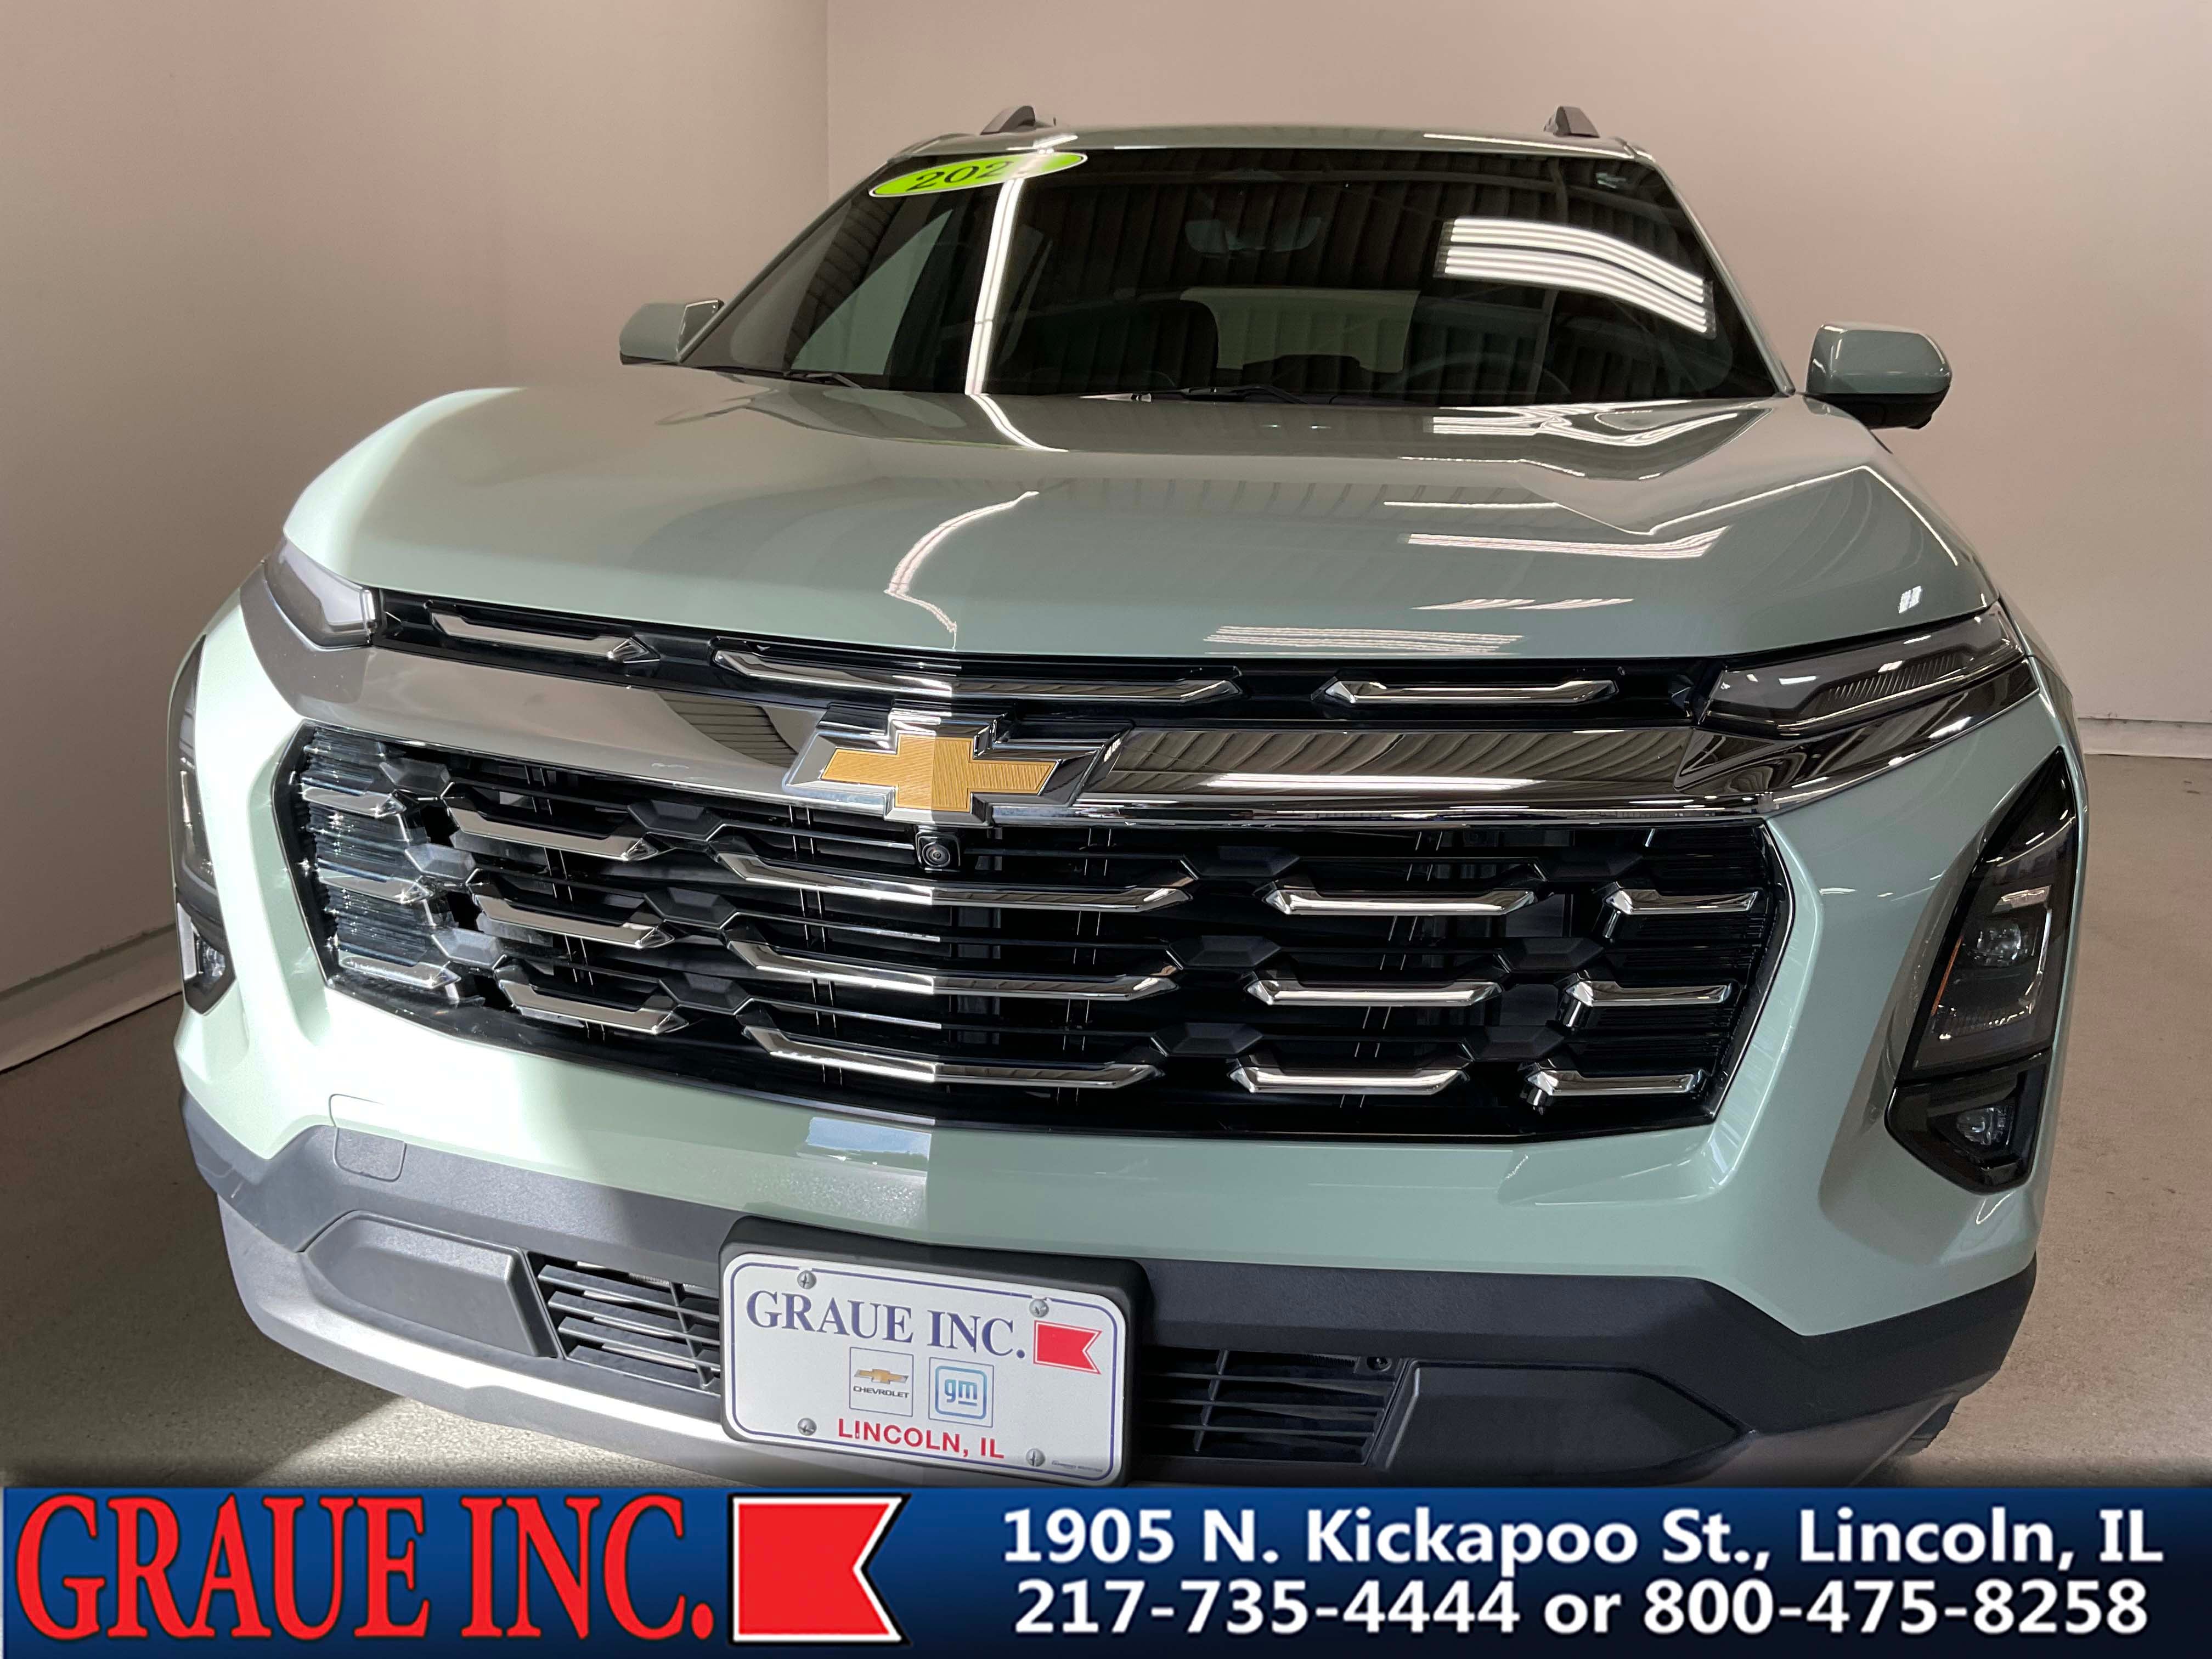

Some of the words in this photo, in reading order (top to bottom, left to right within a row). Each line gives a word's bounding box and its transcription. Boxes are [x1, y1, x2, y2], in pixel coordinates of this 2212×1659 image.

[906, 159, 1034, 191] 202
[746, 1290, 914, 1344] GRAUE
[927, 1309, 1026, 1359] INC.
[853, 1385, 910, 1399] CHEVROLET
[944, 1379, 978, 1407] gm
[838, 1418, 969, 1458] LINCOLN,
[980, 1437, 1005, 1459] IL
